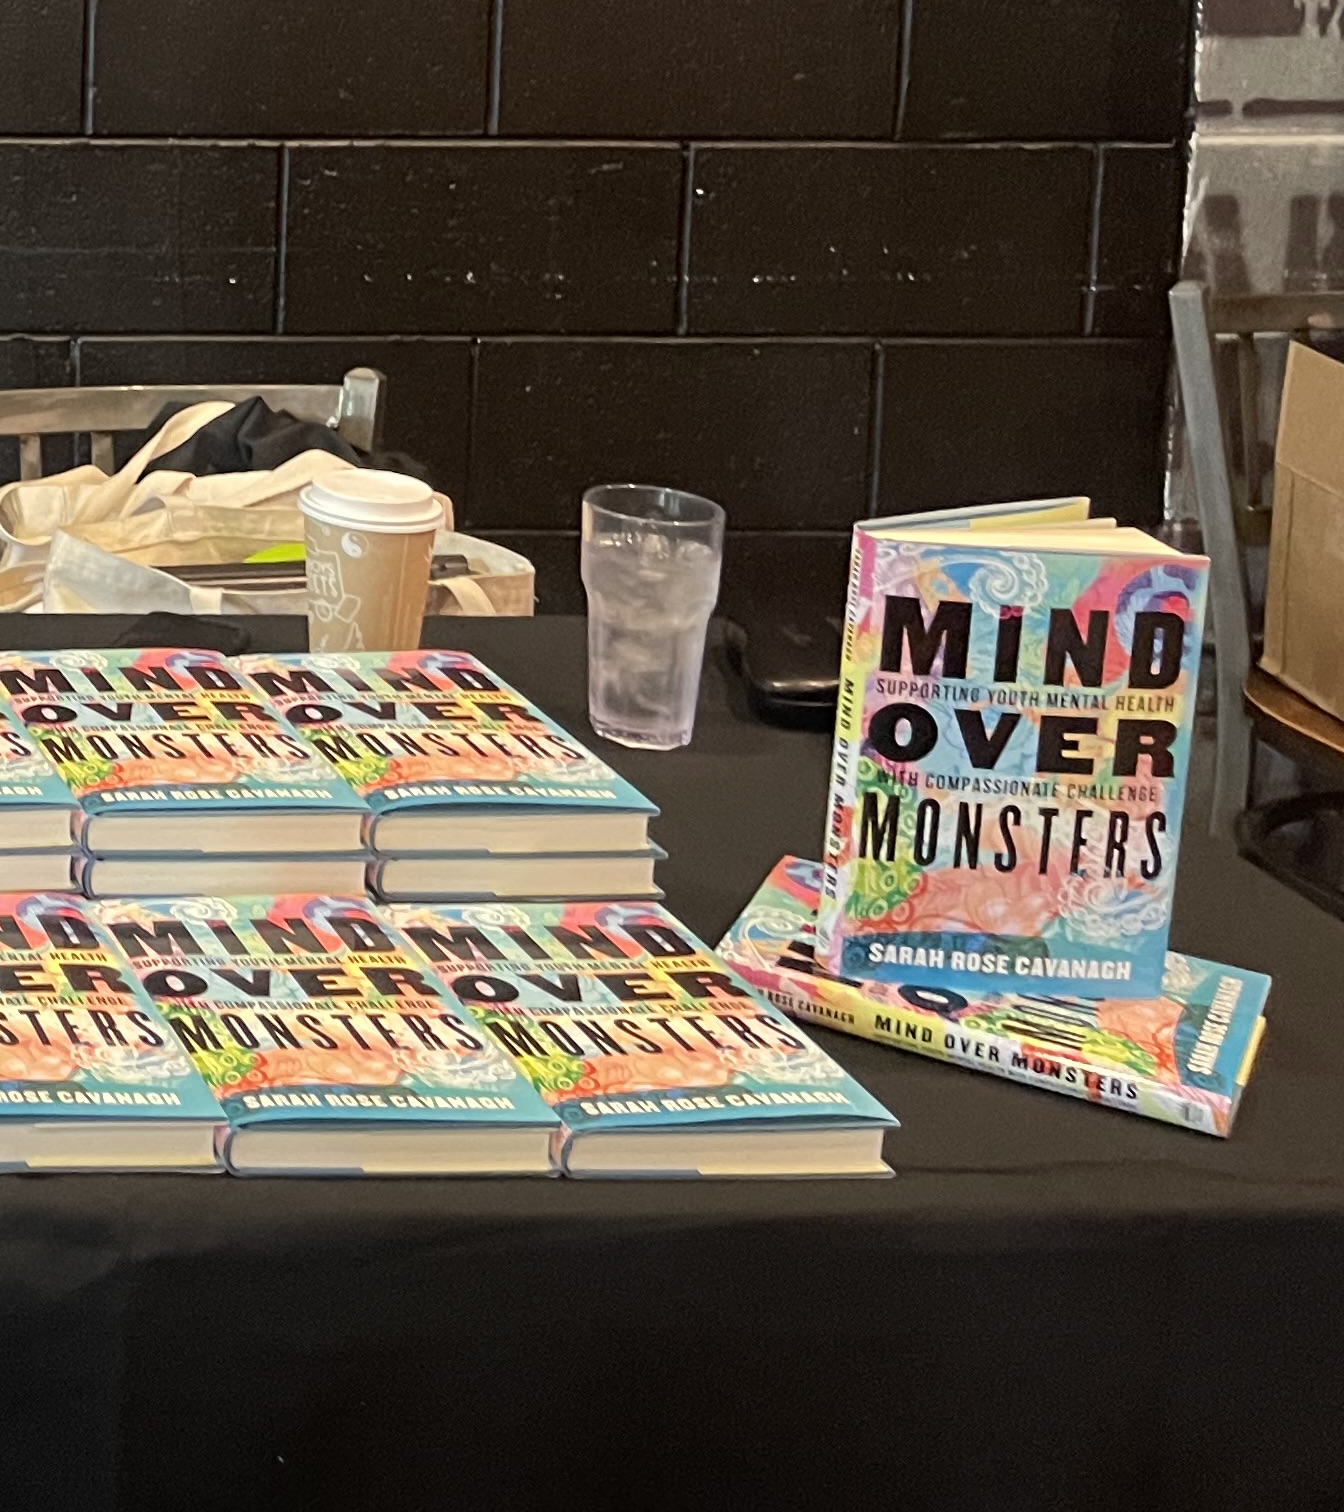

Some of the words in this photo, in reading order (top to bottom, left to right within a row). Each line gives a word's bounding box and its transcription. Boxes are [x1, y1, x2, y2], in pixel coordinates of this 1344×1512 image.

[880, 595, 1185, 689] MIND
[248, 667, 501, 696] MIND
[876, 678, 980, 704] SUPPORTING
[988, 689, 1040, 708] YOUTH
[1046, 692, 1108, 710] MENTAL
[1115, 695, 1175, 712] HEALTH
[21, 702, 279, 723] OVER
[286, 702, 542, 724] OVER
[840, 677, 855, 731] MIND
[41, 734, 310, 764] MONSTERS
[311, 732, 587, 764] MONSTERS
[869, 703, 1175, 778] OVER
[835, 738, 850, 787] OVER
[101, 790, 168, 802] SARAH
[174, 789, 224, 800] ROSE
[228, 787, 333, 799] CAVANAGH
[385, 787, 450, 800] SARAH
[455, 786, 505, 796] ROSE
[508, 787, 616, 799] CAVANAGH
[876, 768, 919, 788] WITH
[925, 774, 1058, 798] COMPASSIONATE
[1067, 783, 1157, 802] CHALLENGE
[825, 793, 846, 901] MONSTERS
[859, 792, 1166, 880] MONSTERS
[106, 918, 397, 957] MIND
[403, 924, 696, 961] MIND
[868, 943, 944, 968] SARAH
[952, 953, 1010, 974] ROSE
[1015, 958, 1131, 980] CAVANAGH
[143, 967, 443, 997] OVER
[452, 971, 756, 1001] OVER
[170, 1012, 484, 1054] MONSTERS
[488, 1013, 806, 1058] MONSTERS
[874, 1013, 934, 1044] MIND
[943, 1032, 1001, 1062] OVER
[1010, 1051, 1139, 1101] MONSTERS
[59, 1091, 181, 1106] CAVANAGH
[243, 1092, 316, 1109] SARAH
[325, 1093, 388, 1108] ROSE
[395, 1094, 515, 1109] CAVANAGH
[580, 1099, 657, 1115] SARAH
[663, 1096, 723, 1110] ROSE
[727, 1091, 849, 1106] CAVANAGH
